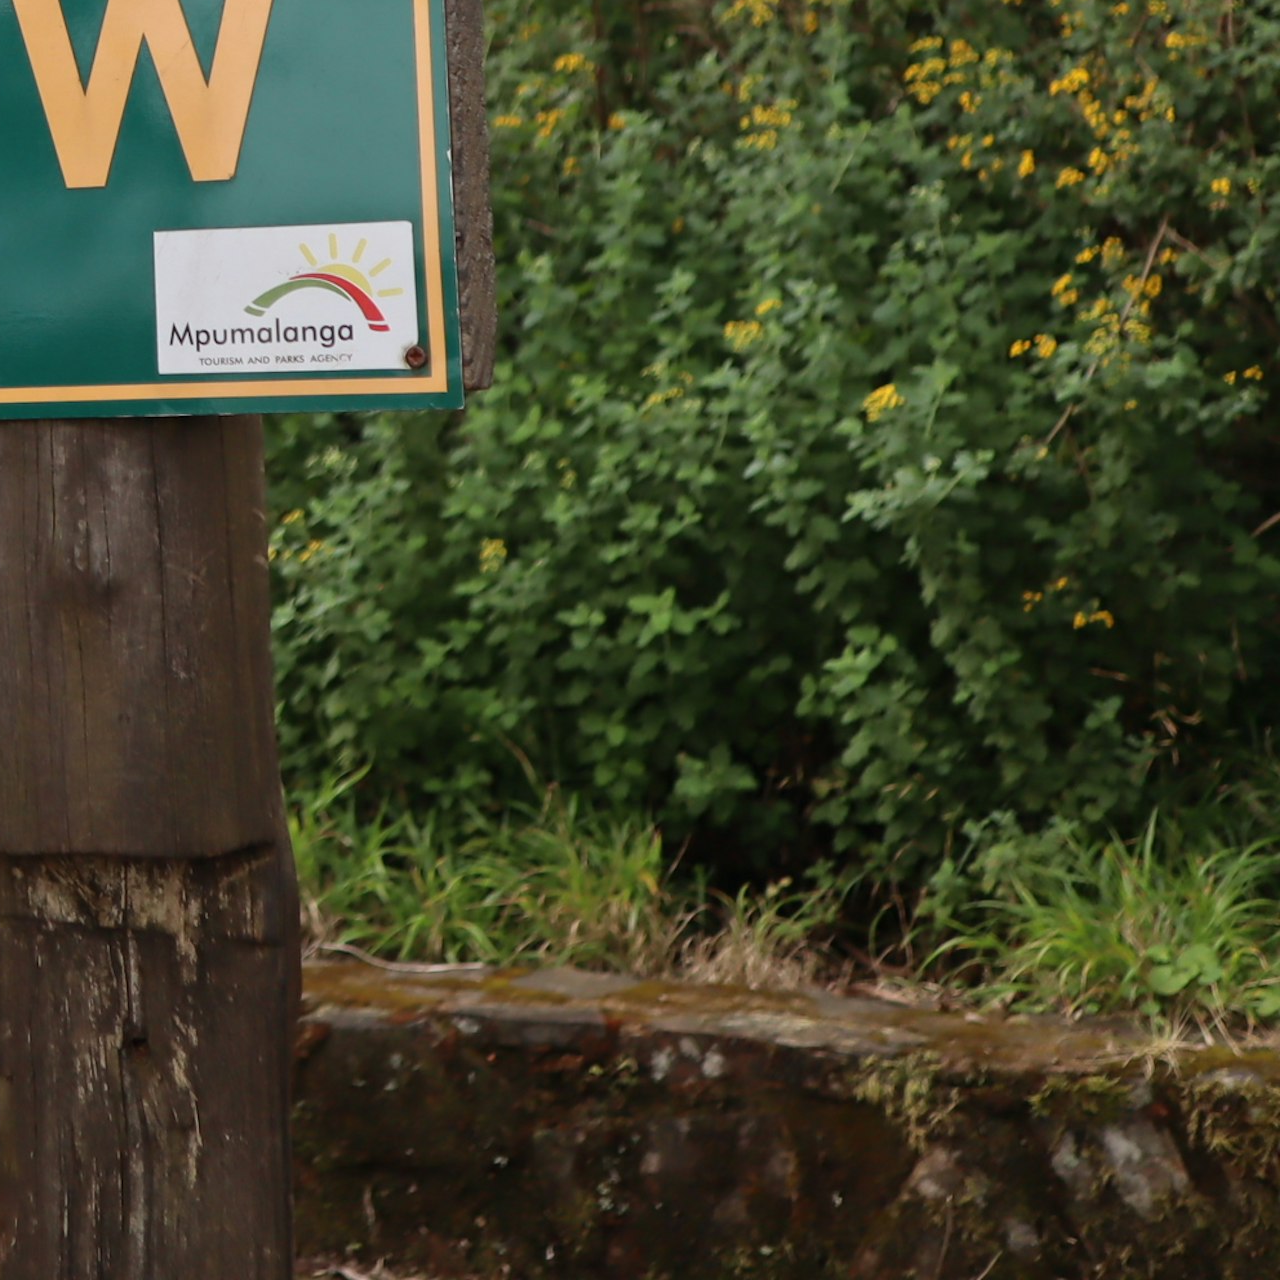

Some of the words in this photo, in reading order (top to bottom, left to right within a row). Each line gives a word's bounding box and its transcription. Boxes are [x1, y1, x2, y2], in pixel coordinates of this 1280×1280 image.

[169, 317, 354, 352] Mpumalanga
[198, 356, 244, 366] TOURISM
[247, 355, 271, 365] AND
[275, 354, 305, 364] PARKS
[310, 353, 353, 363] AGENCY
